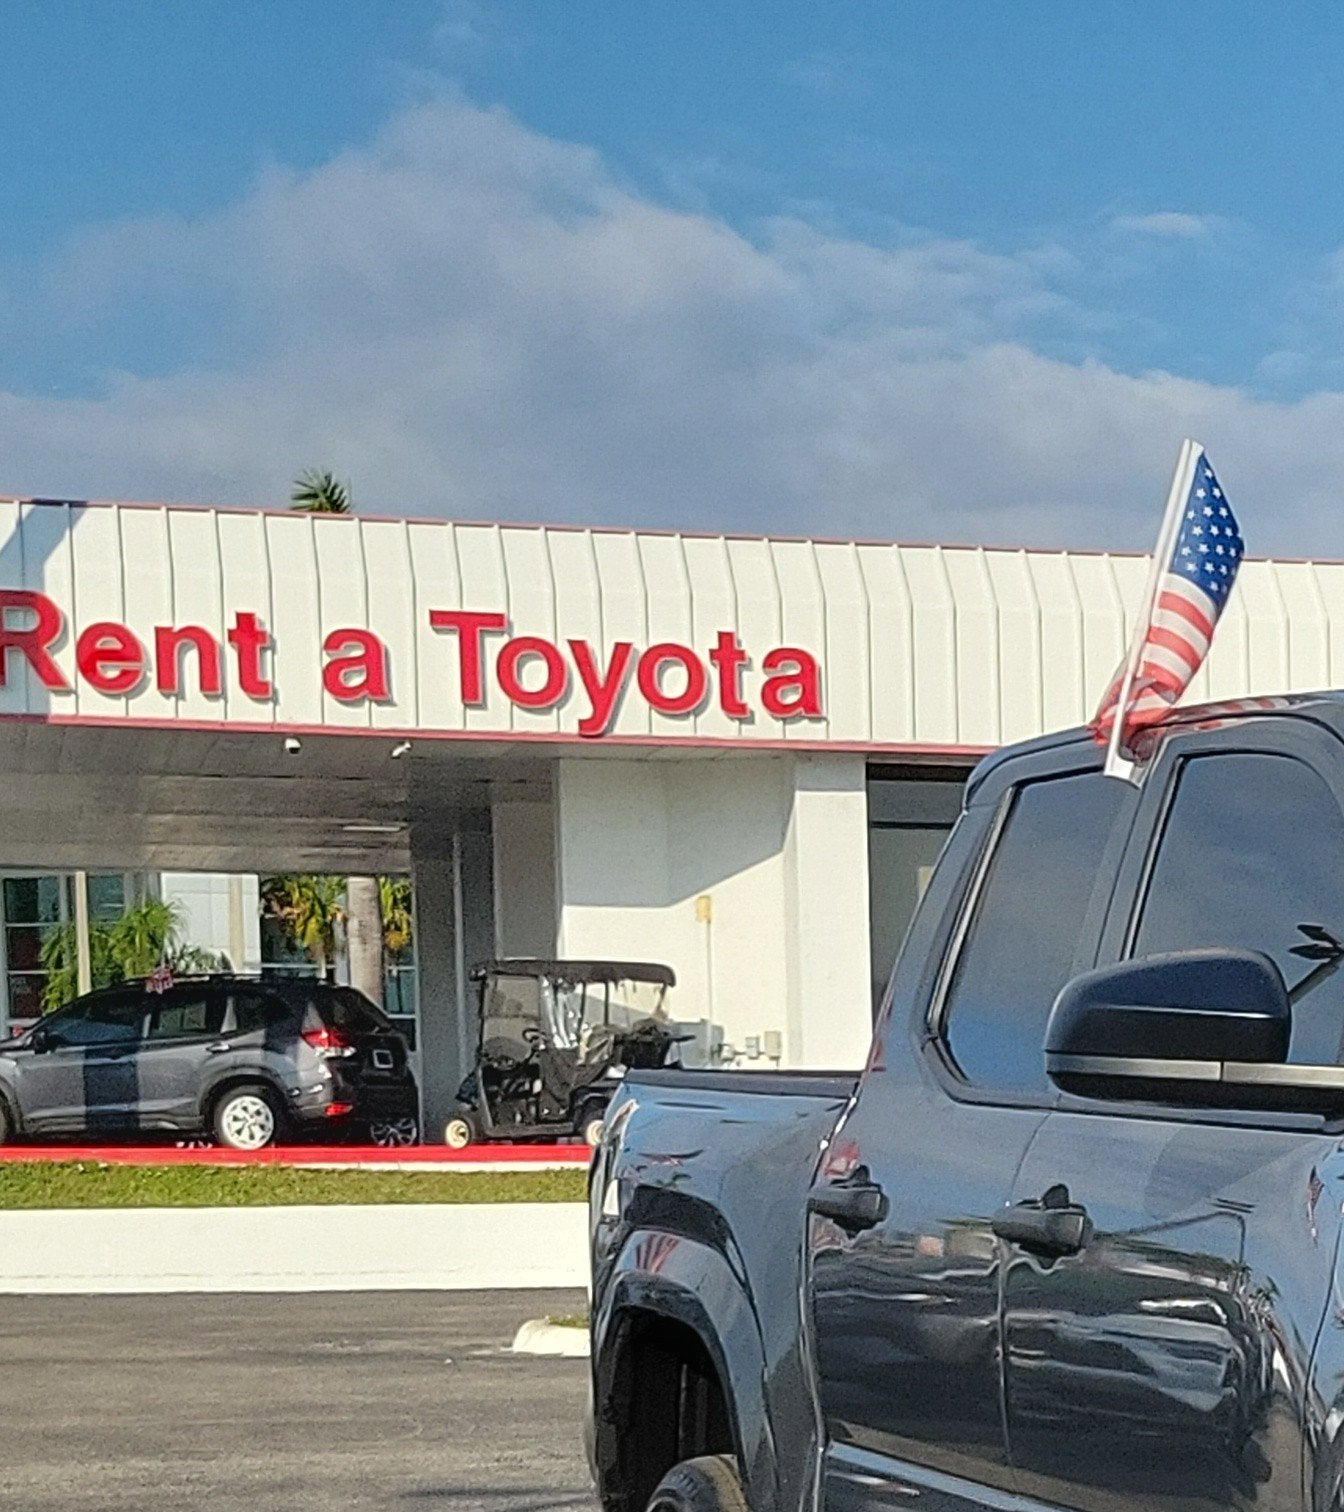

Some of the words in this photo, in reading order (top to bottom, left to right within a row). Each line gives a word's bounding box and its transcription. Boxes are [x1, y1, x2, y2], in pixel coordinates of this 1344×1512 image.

[0, 590, 272, 699] Rent
[322, 628, 389, 702] a
[429, 609, 823, 736] Toyota
